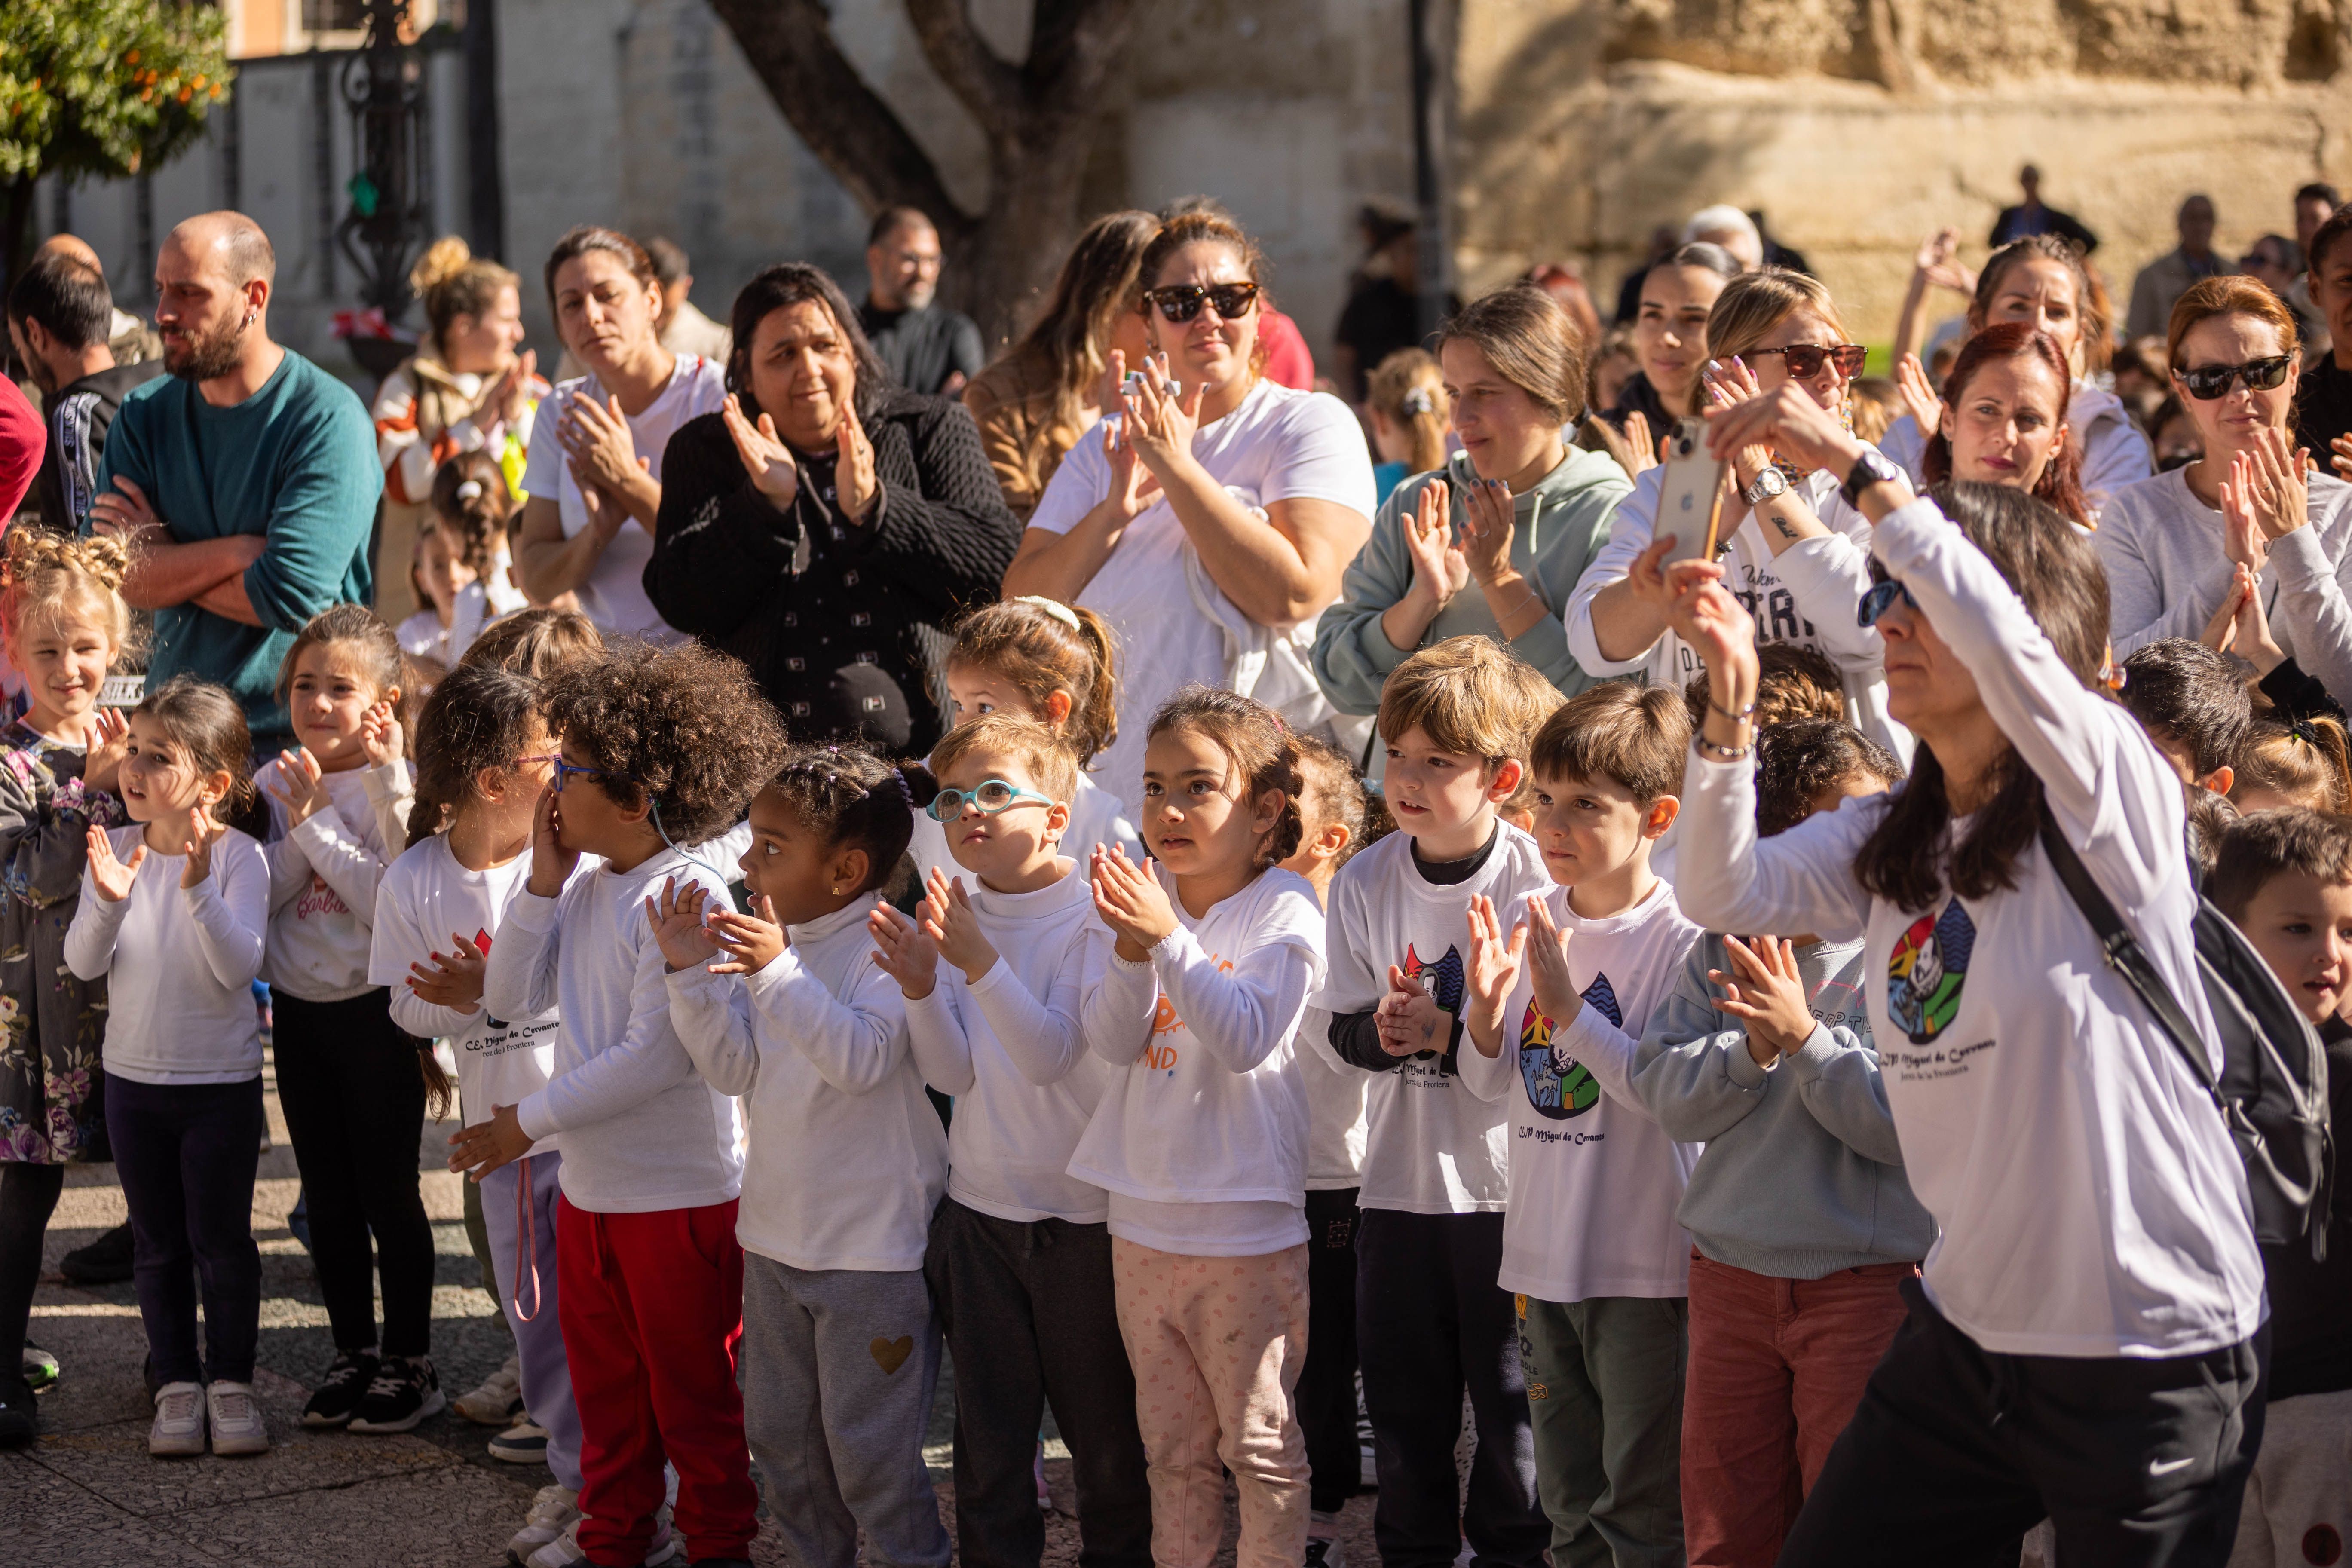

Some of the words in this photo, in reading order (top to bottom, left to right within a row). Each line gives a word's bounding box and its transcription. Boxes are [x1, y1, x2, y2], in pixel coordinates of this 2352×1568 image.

[509, 1030, 518, 1039] de
[522, 1022, 559, 1037] Cervante
[506, 1040, 535, 1052] Frontera
[1430, 1066, 1436, 1075] de
[1563, 1132, 1571, 1141] de
